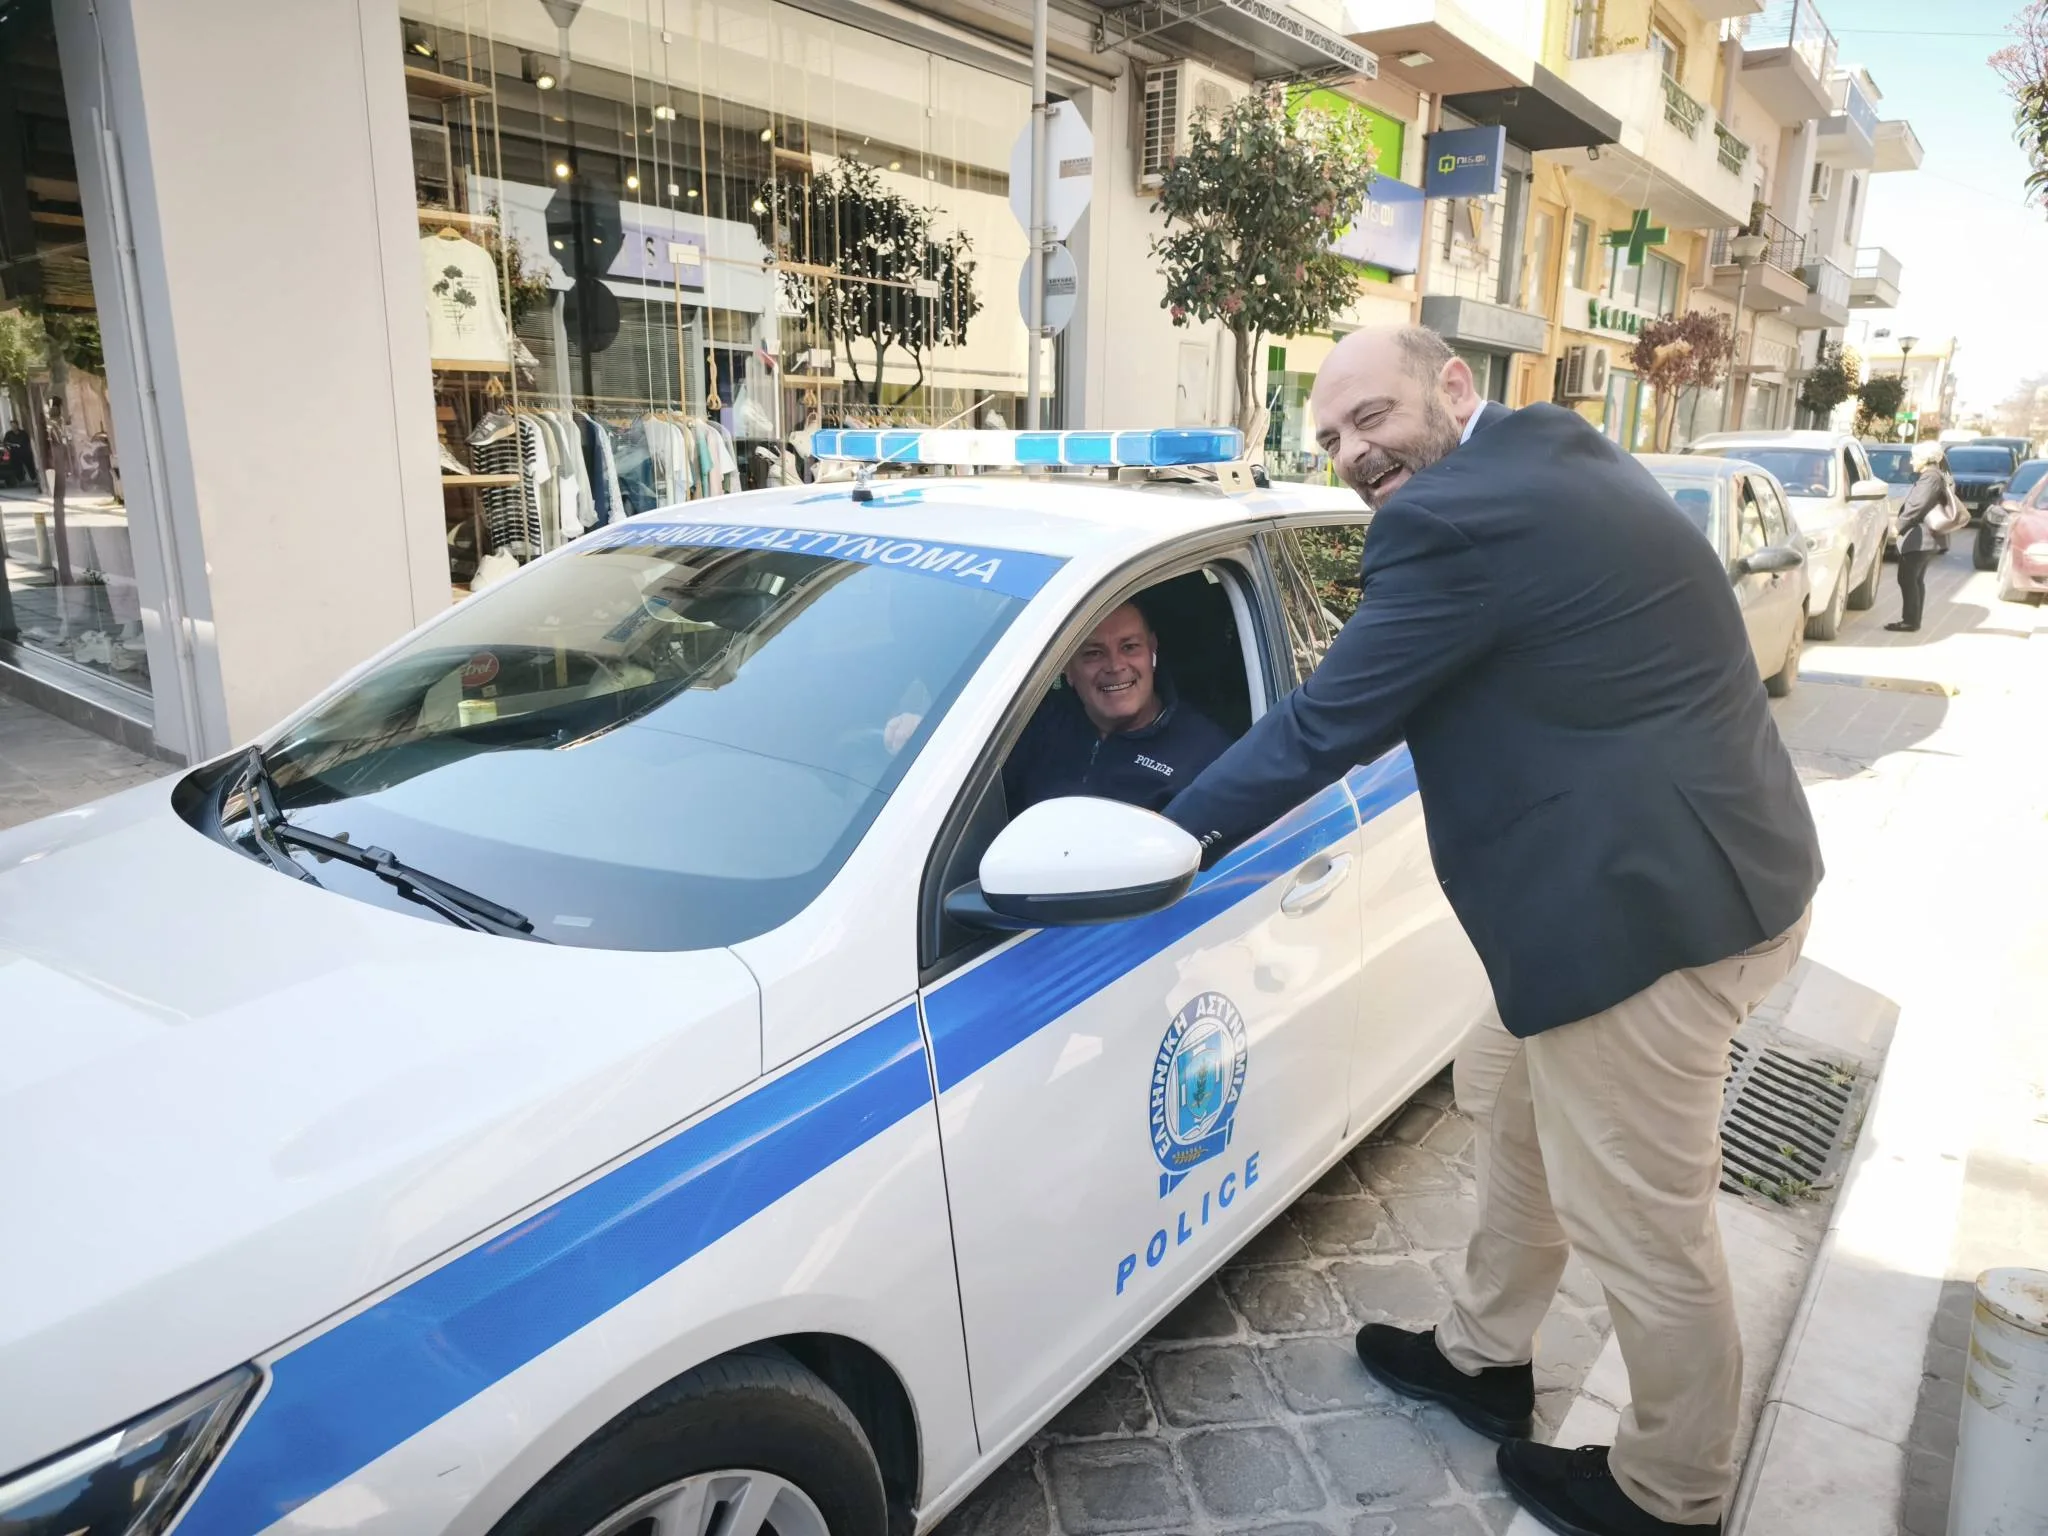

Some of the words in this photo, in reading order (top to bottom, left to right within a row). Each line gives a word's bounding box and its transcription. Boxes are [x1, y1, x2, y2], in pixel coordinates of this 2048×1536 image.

[741, 527, 1003, 584] ΑΣΤΥΝΟΜΙΑ
[1134, 754, 1174, 777] POLICE
[1151, 1011, 1189, 1159] ΕΛΛΗΝΙΚΗ
[1195, 996, 1247, 1104] ΑΣΤΥΝΟΜΙΑ
[1116, 1150, 1260, 1297] POLICE
